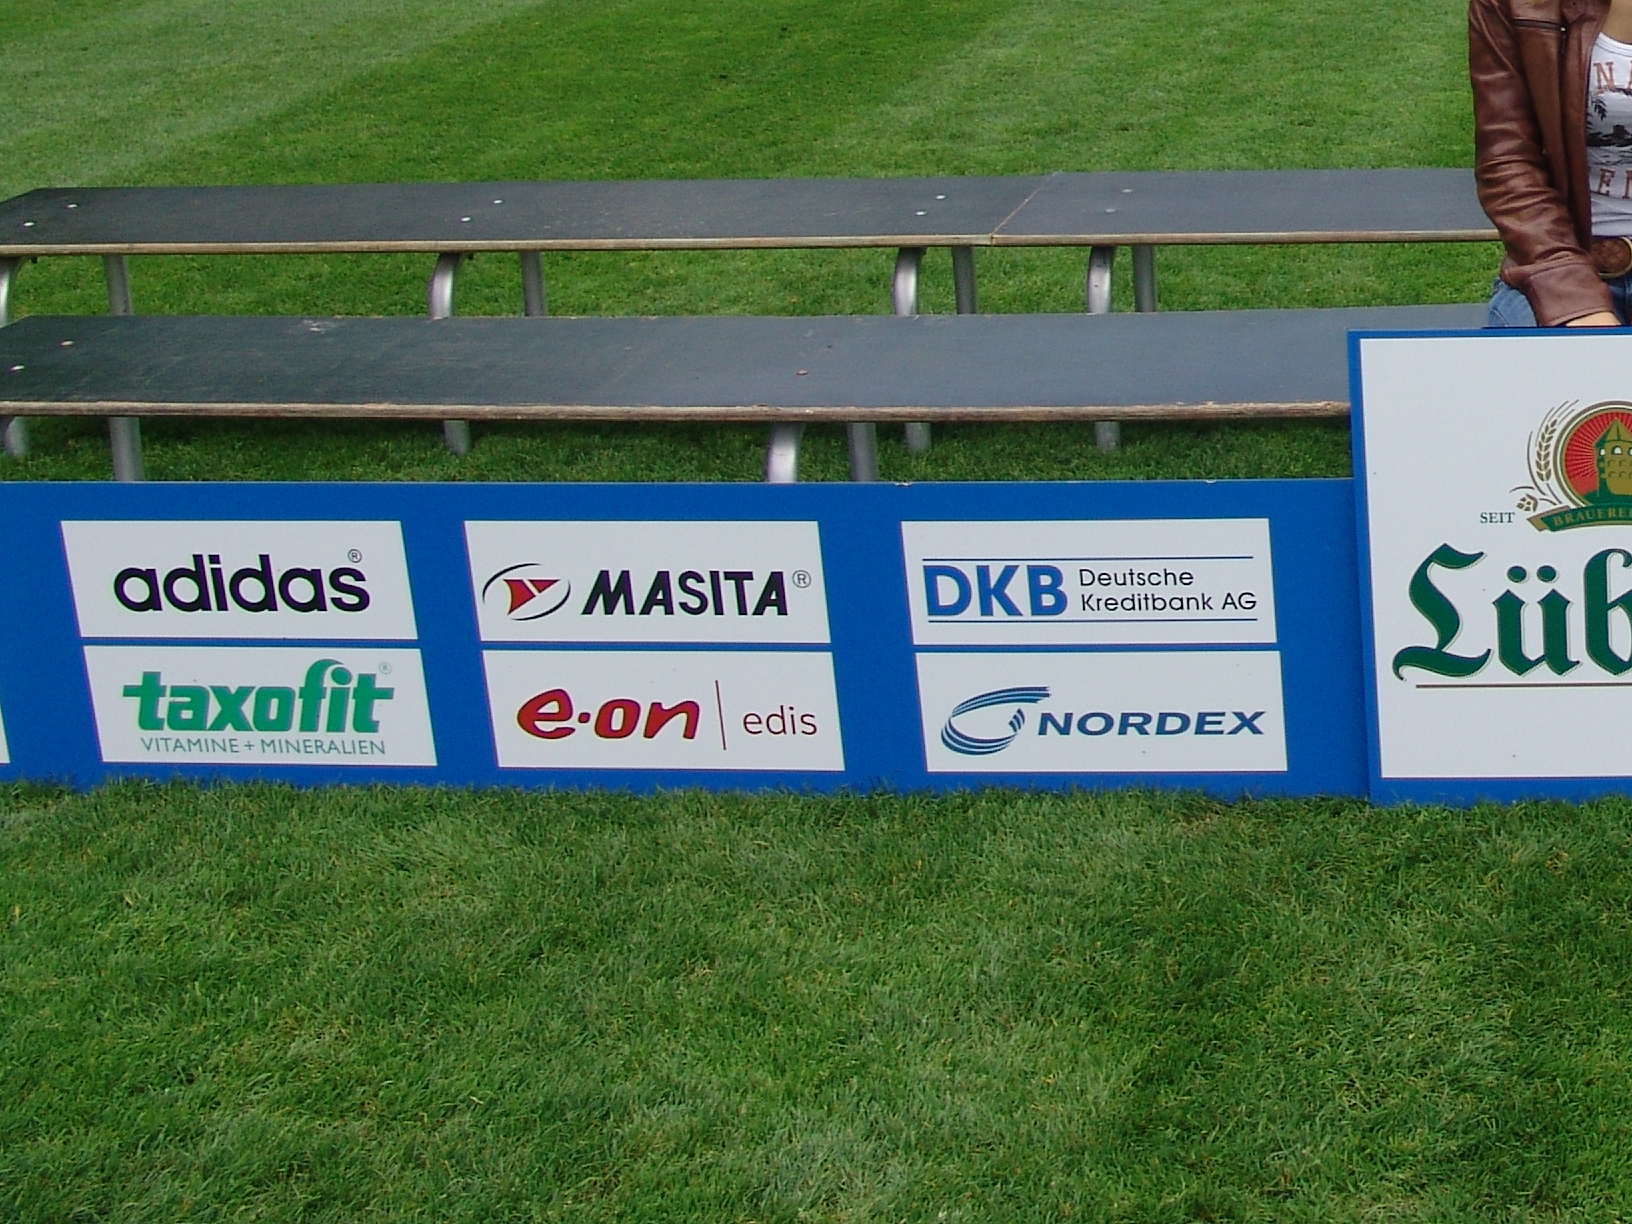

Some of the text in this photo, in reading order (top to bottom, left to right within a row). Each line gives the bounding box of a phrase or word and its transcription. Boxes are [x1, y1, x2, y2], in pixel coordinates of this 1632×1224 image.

[1479, 511, 1516, 524] SEIT
[1553, 507, 1630, 527] BRAUEREI
[1079, 567, 1194, 587] Deutsche
[922, 564, 1068, 617] DKB
[1081, 591, 1257, 612] Kreditbank AG
[742, 705, 818, 736] edis
[1037, 710, 1266, 736] NORDEX
[141, 737, 386, 755] VITAMINE + MINERALIEN
